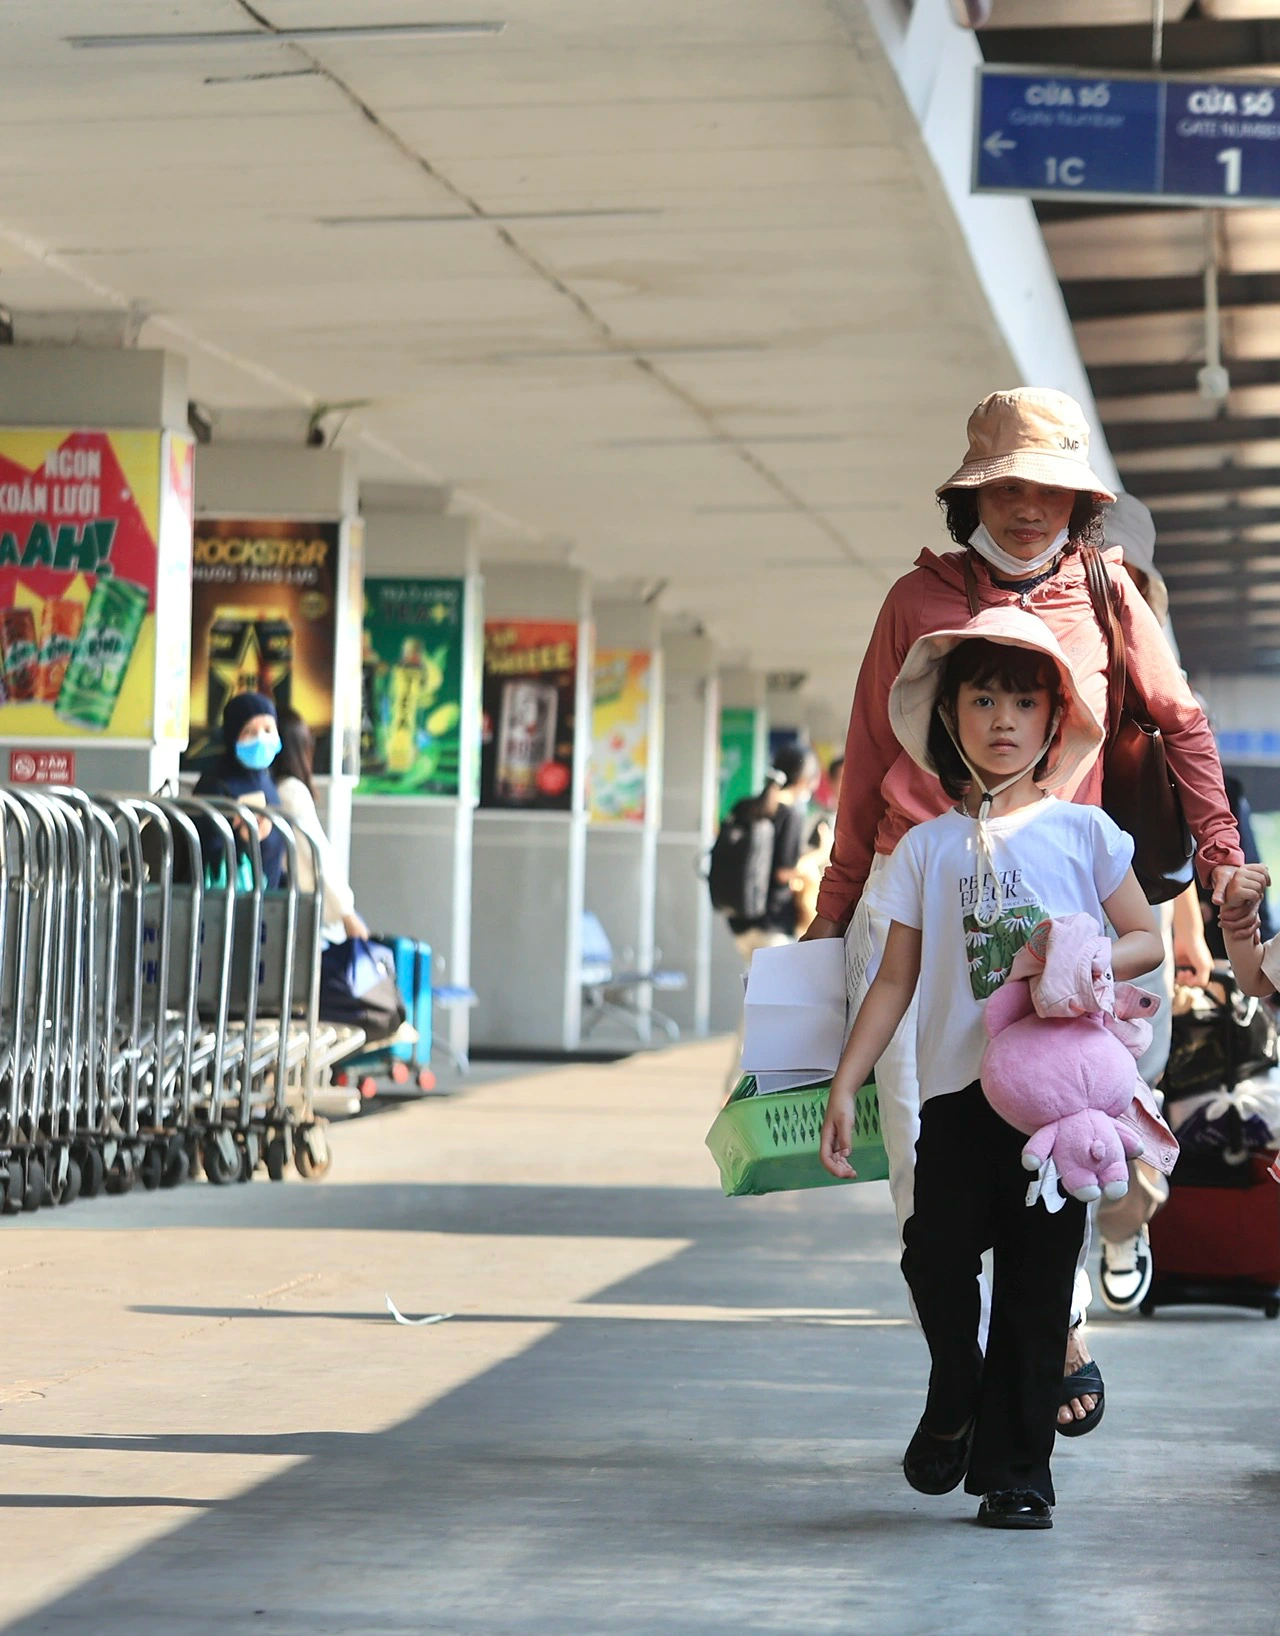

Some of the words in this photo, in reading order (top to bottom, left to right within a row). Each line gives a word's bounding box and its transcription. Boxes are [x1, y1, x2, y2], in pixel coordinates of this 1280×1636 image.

[1045, 156, 1085, 186] 1C
[1216, 147, 1242, 195] 1
[959, 869, 1022, 892] PETTE
